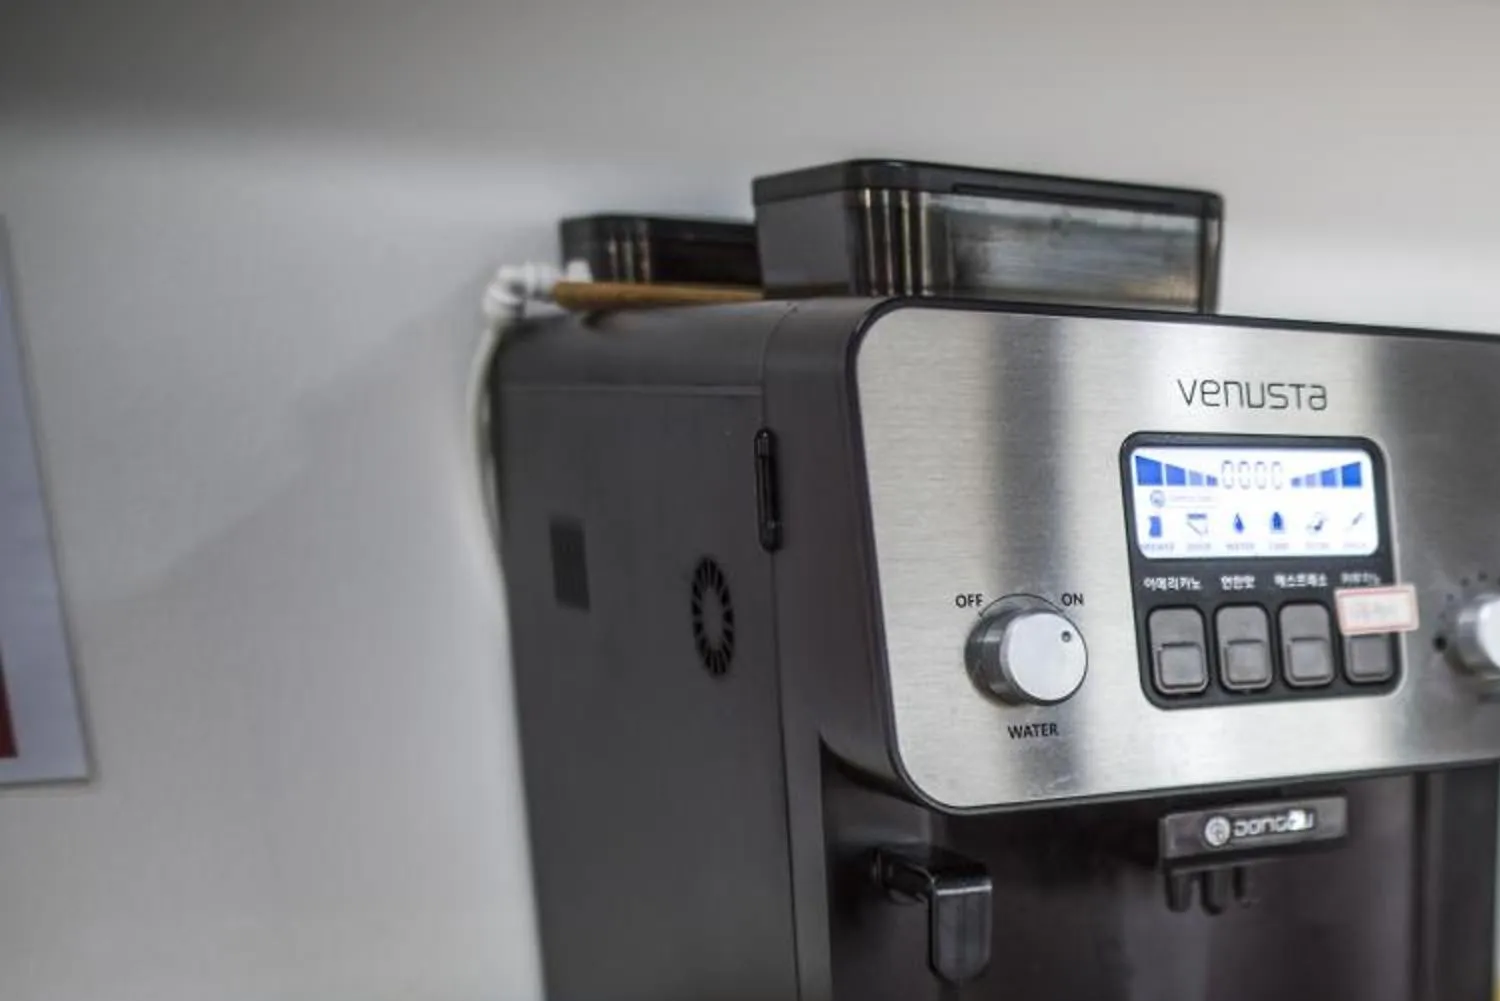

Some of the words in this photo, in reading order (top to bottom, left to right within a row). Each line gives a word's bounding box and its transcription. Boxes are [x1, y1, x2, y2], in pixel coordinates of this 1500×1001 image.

[1143, 575, 1202, 591] 아메리카노
[955, 592, 984, 608] OFF
[1061, 592, 1085, 606] ON
[1007, 722, 1059, 739] WATER
